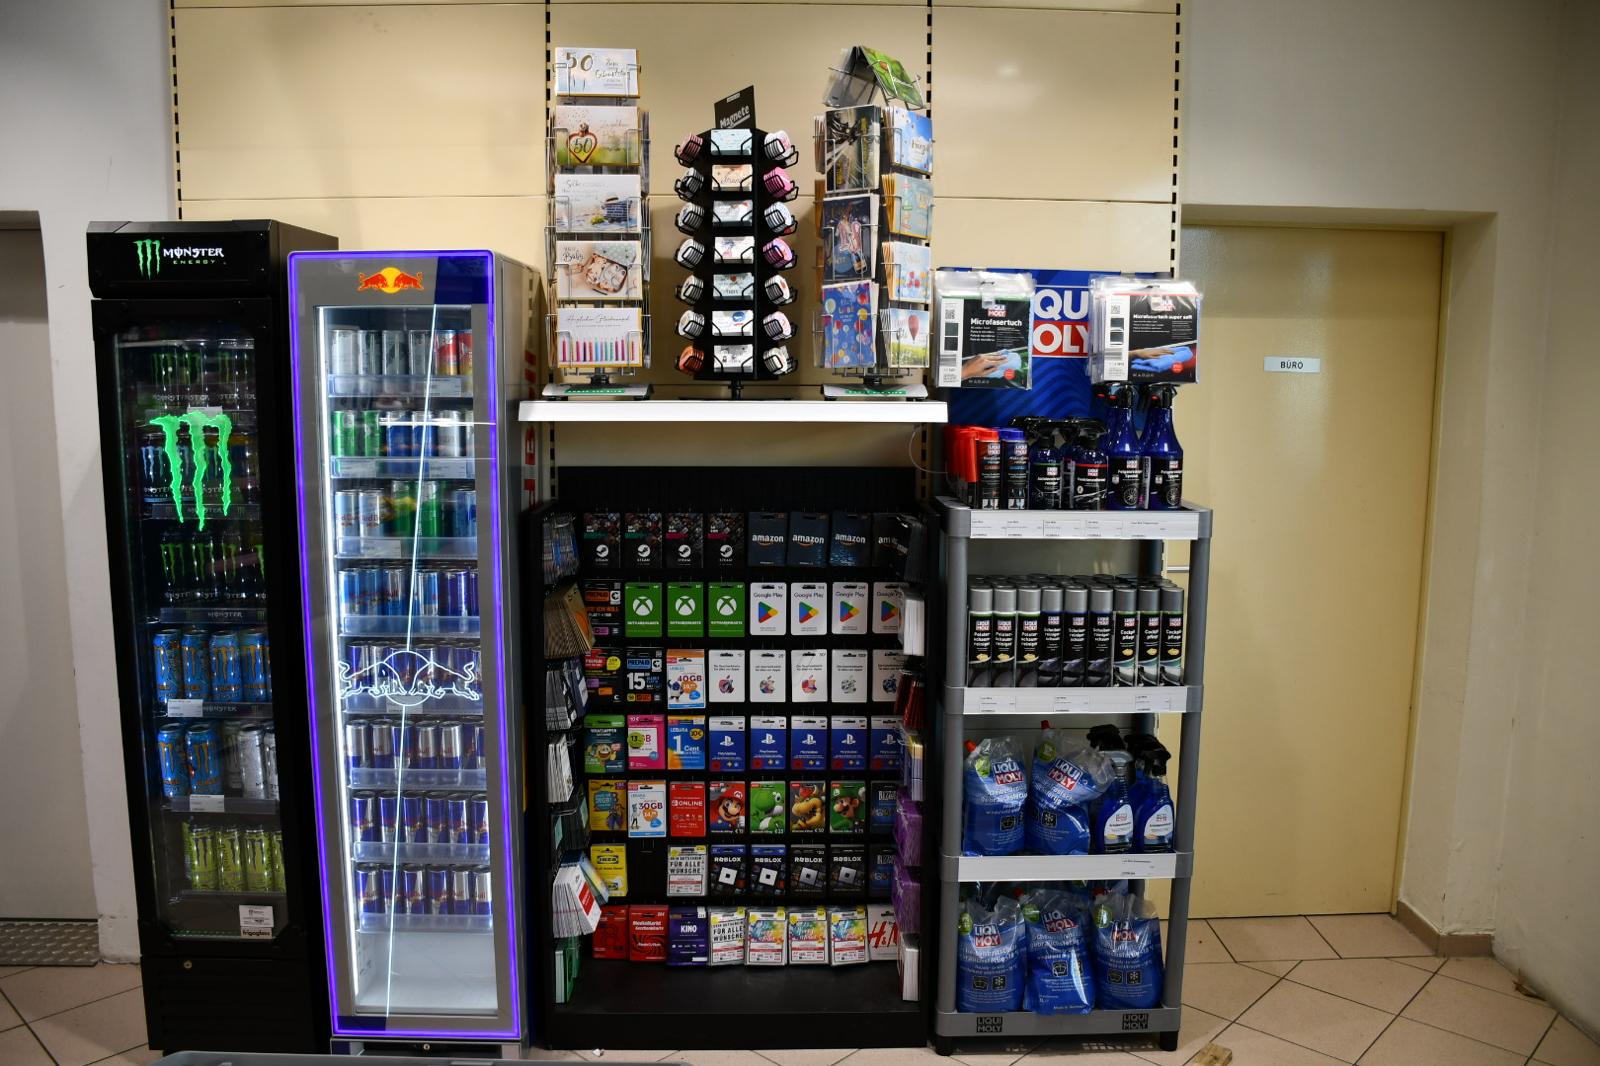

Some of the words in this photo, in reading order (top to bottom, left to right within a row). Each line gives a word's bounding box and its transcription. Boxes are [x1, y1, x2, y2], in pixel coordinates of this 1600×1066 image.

[573, 138, 592, 153] 50
[163, 247, 224, 258] MONSTER
[970, 318, 1022, 326] Microfasertuch
[1280, 360, 1303, 369] BÜRO
[752, 534, 784, 542] amazon
[793, 534, 825, 544] amazon
[835, 533, 866, 544] amazon
[627, 672, 646, 690] 15
[673, 735, 683, 754] 1
[993, 761, 1020, 774] LIQUI
[1055, 759, 1082, 781] LIQUI
[996, 771, 1022, 784] MOLY
[1049, 768, 1076, 790] MOLY
[681, 925, 697, 933] KINO
[1123, 1014, 1148, 1022] LIQUI
[1123, 1022, 1148, 1030] MOLY
